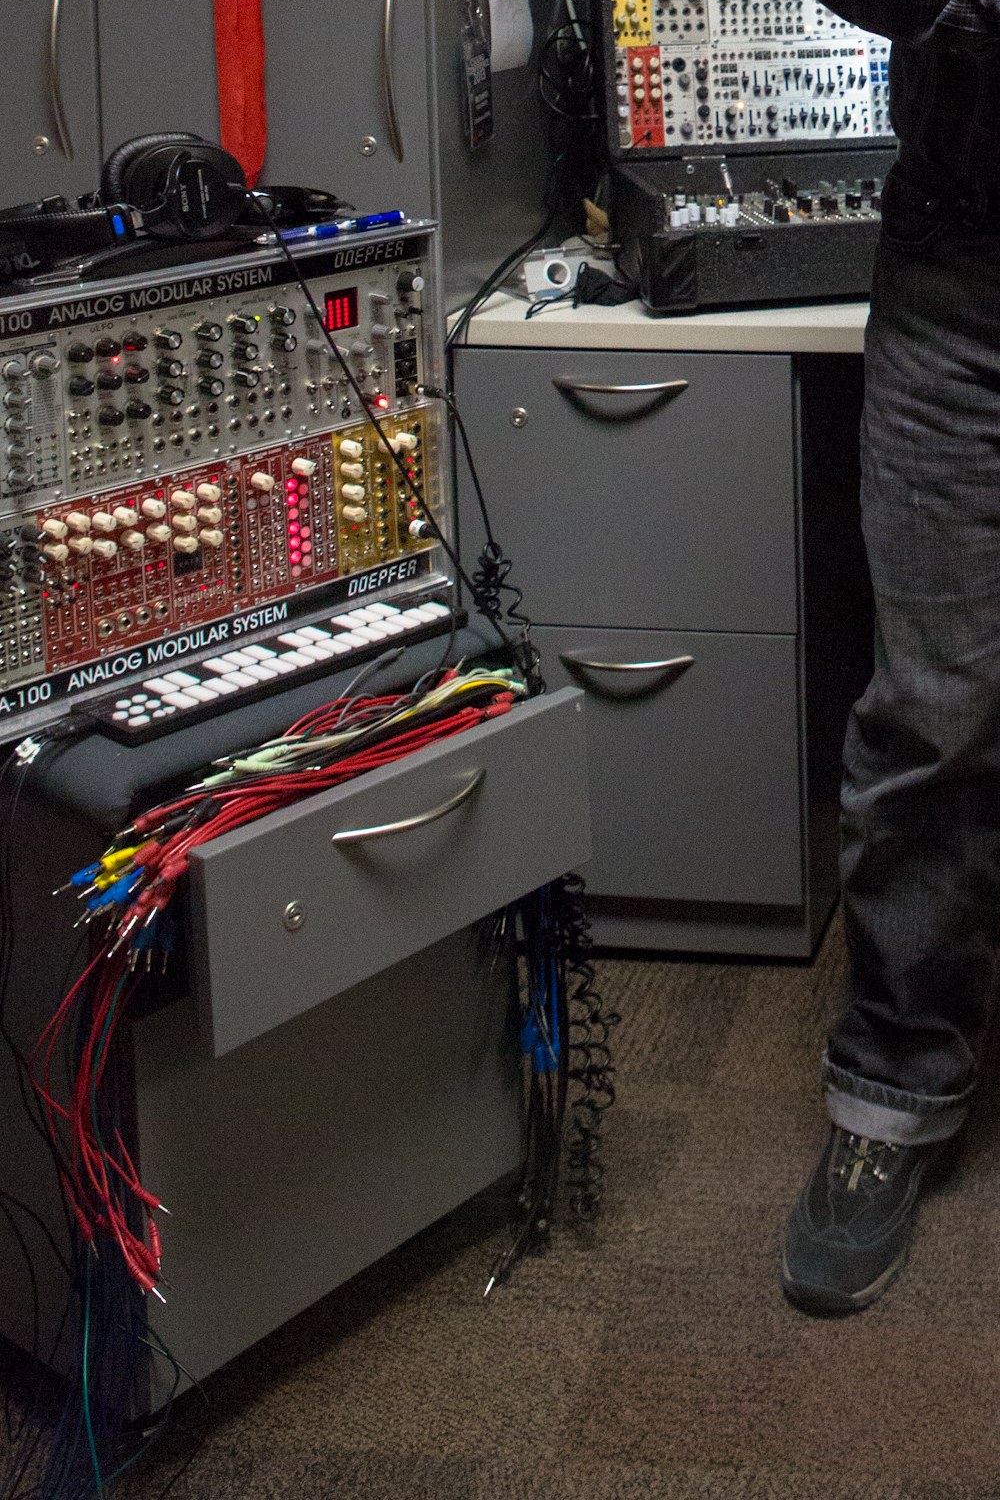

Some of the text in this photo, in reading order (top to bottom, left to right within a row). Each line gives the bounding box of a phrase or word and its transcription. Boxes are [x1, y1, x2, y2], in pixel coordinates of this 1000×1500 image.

[180, 183, 190, 212] SONY
[335, 241, 404, 269] DOEPFER
[49, 297, 125, 325] ANALOG
[130, 278, 212, 316] MODULAR
[217, 267, 273, 292] SYSTEM
[348, 559, 418, 597] DOEPFER
[0, 602, 288, 713] A-100 ANALOG MODULAR SYSTEM
